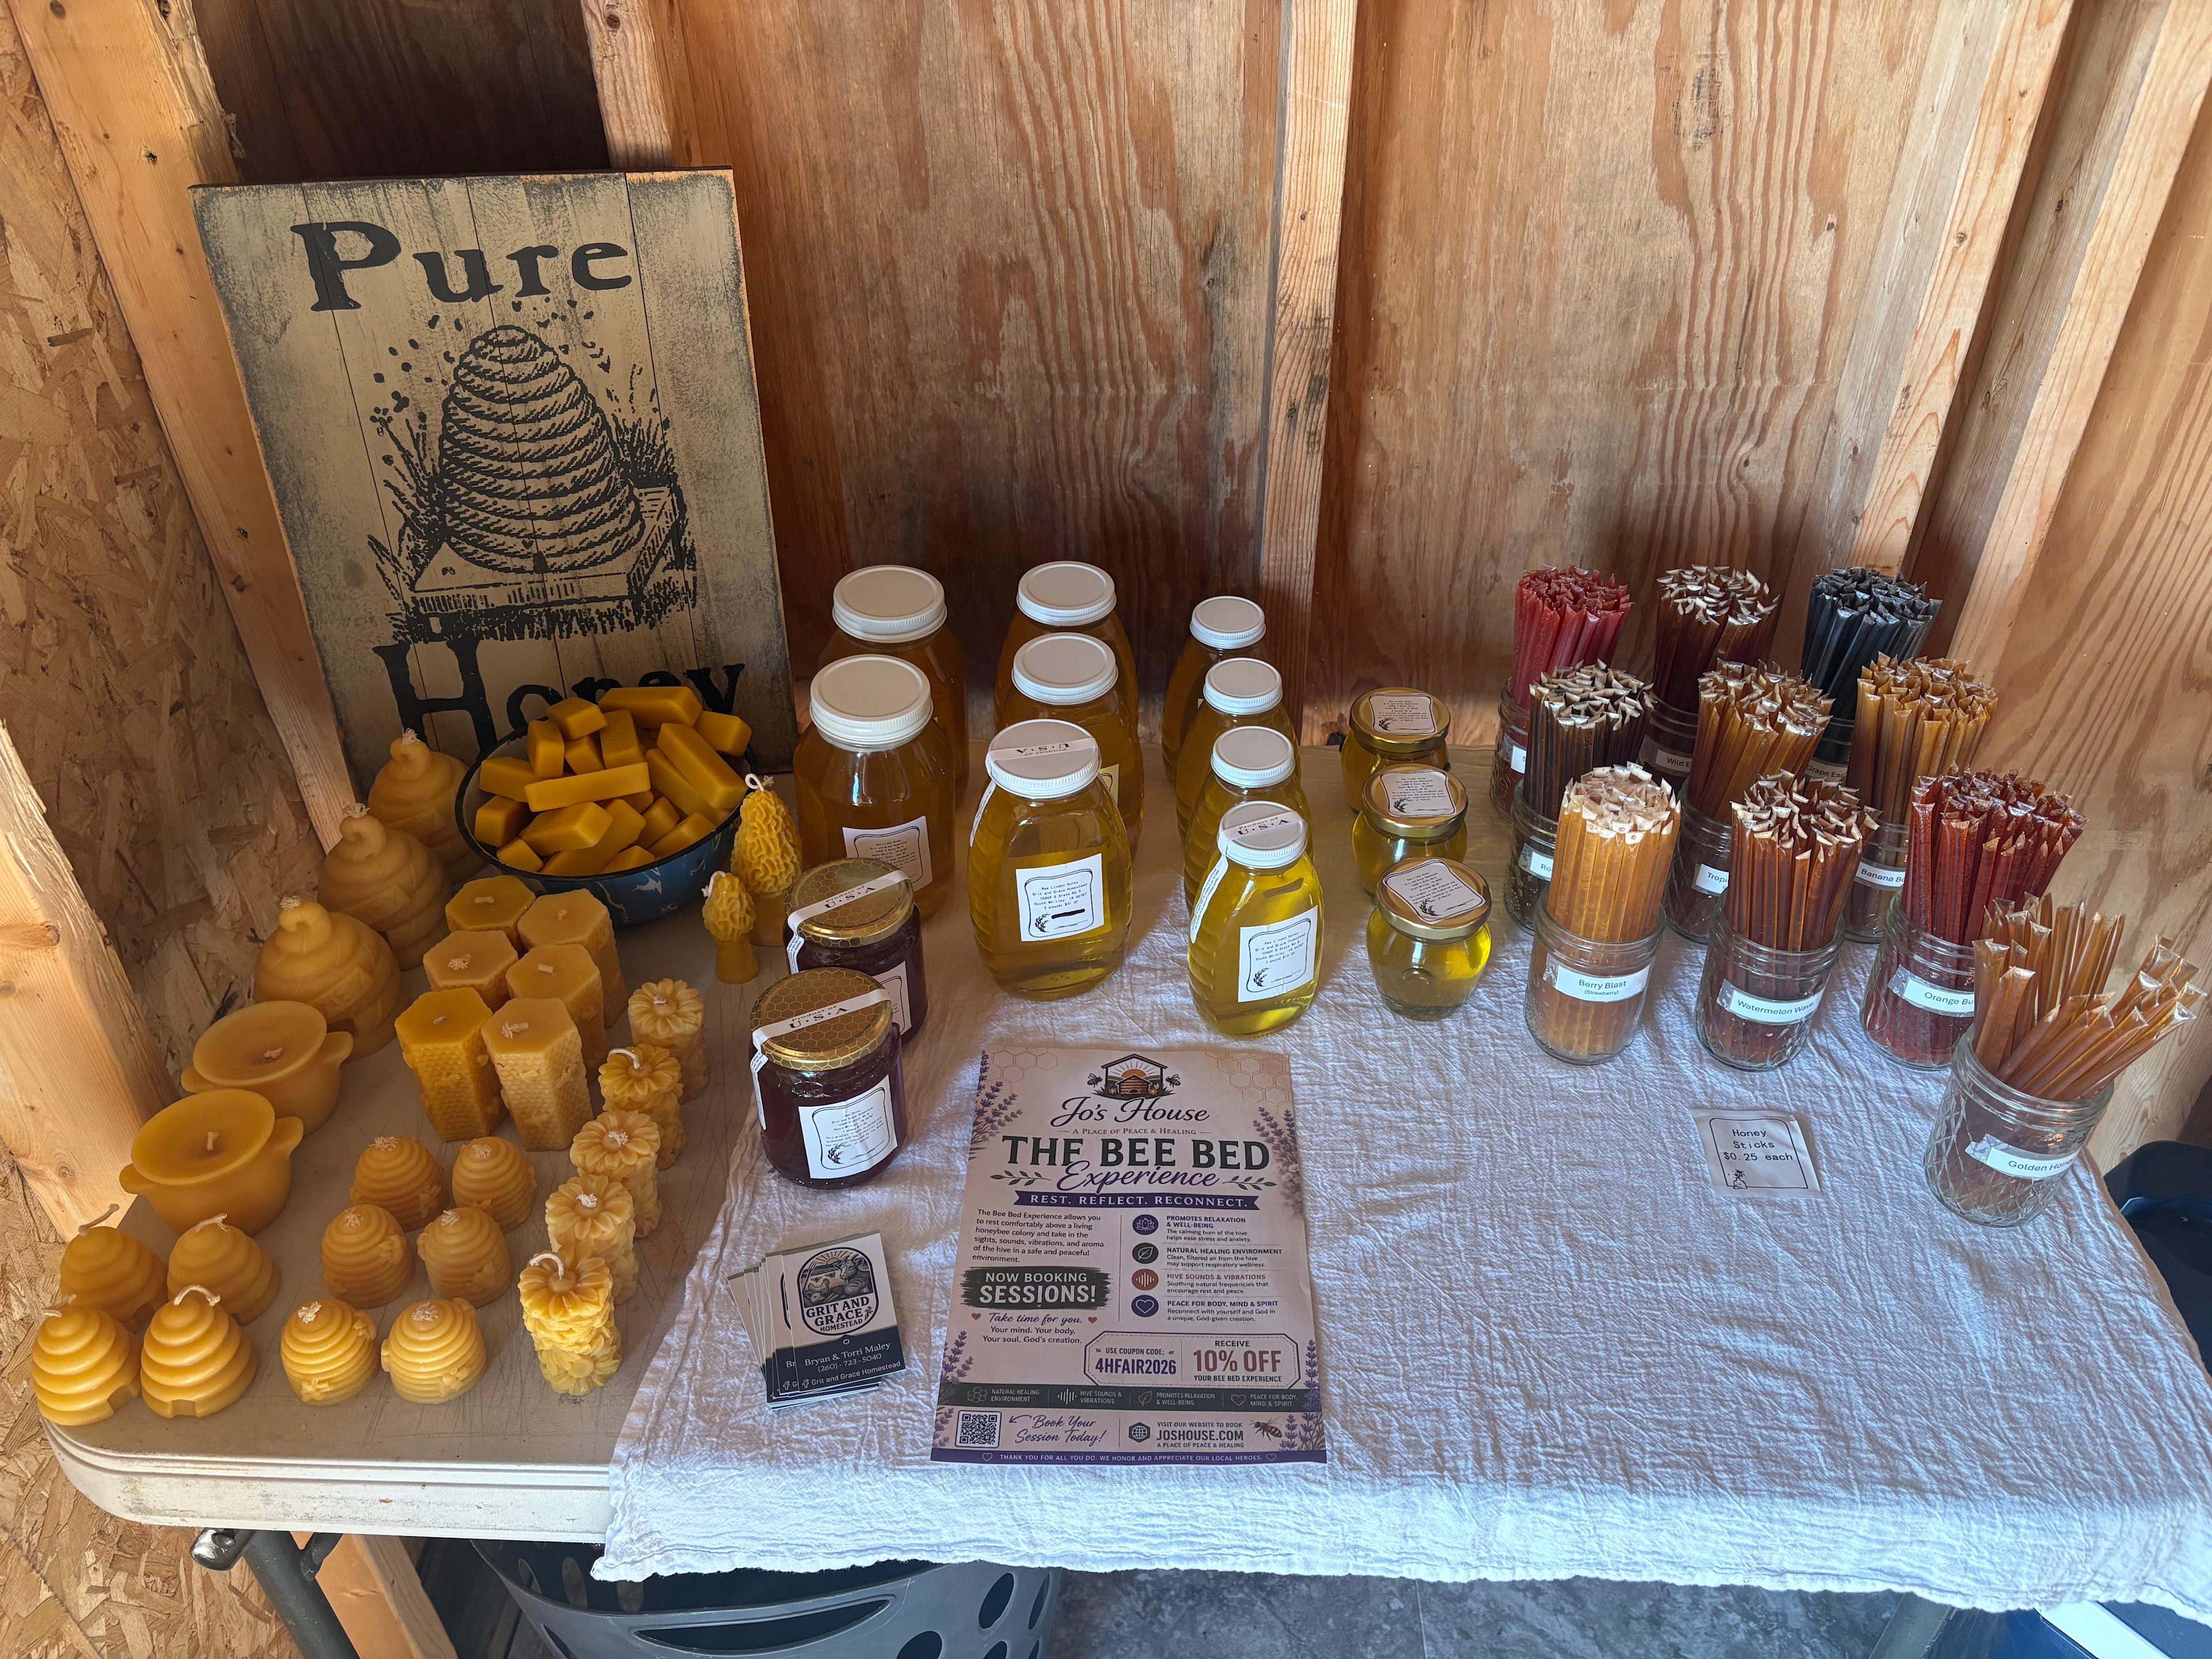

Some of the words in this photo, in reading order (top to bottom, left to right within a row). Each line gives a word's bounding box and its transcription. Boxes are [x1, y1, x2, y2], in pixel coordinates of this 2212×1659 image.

[290, 221, 632, 311] Pure
[1667, 757, 1684, 766] Wild
[1806, 765, 1830, 777] Grape
[1239, 820, 1268, 830] Product
[1861, 868, 1893, 882] Banana
[1579, 979, 1603, 990] Berry
[1605, 980, 1627, 989] Blast
[1925, 992, 1960, 1005] Orange
[1737, 999, 1792, 1014] Watermelon
[1794, 1002, 1814, 1013] Wave
[792, 1009, 824, 1021] Product
[1050, 1096, 1108, 1127] Jo's
[1114, 1097, 1210, 1123] House
[1732, 1128, 1766, 1138] Honey
[1733, 1141, 1775, 1149] Sticks
[1002, 1135, 1084, 1166] THE
[1100, 1138, 1176, 1167] BEE
[1192, 1139, 1270, 1170] BED
[1723, 1152, 1758, 1162] $0.25
[1765, 1153, 1793, 1161] each
[2008, 1160, 2047, 1172] Golden
[1056, 1160, 1221, 1195] Experience
[1031, 1195, 1071, 1204] REST.
[1079, 1194, 1147, 1205] REFLECT.
[1154, 1196, 1247, 1207] RECONNECT.
[975, 1226, 1010, 1235] honeybee
[1012, 1229, 1035, 1237] colony
[1001, 1220, 1043, 1229] comfortably
[1074, 1222, 1092, 1230] living
[972, 1254, 1020, 1262] environment.
[986, 1272, 1018, 1282] NOW
[1024, 1272, 1086, 1282] BOOKING
[979, 1285, 1095, 1303] SESSIONS!
[806, 1303, 839, 1318] GRIT
[842, 1296, 869, 1310] AND
[815, 1308, 863, 1326] GRACE
[988, 1312, 1013, 1323] Take
[1041, 1313, 1058, 1325] for
[1060, 1317, 1082, 1326] you.
[820, 1319, 863, 1332] HOMESTEAD
[1054, 1327, 1075, 1335] body.
[805, 1357, 830, 1367] Bryan
[840, 1349, 863, 1358] Torri
[865, 1343, 891, 1354] Maley
[1193, 1350, 1237, 1372] 10%
[1243, 1350, 1281, 1372] OFF
[1095, 1358, 1176, 1374] 4HFAIR2026
[812, 1377, 824, 1385] Grit
[840, 1372, 861, 1380] Grace
[862, 1361, 901, 1375] Homestead
[1032, 1415, 1065, 1429] Book
[1068, 1415, 1096, 1429] Your
[1015, 1430, 1060, 1444] Session
[1065, 1430, 1107, 1447] Today!
[1156, 1430, 1243, 1441] JOSHOUSE.COM
